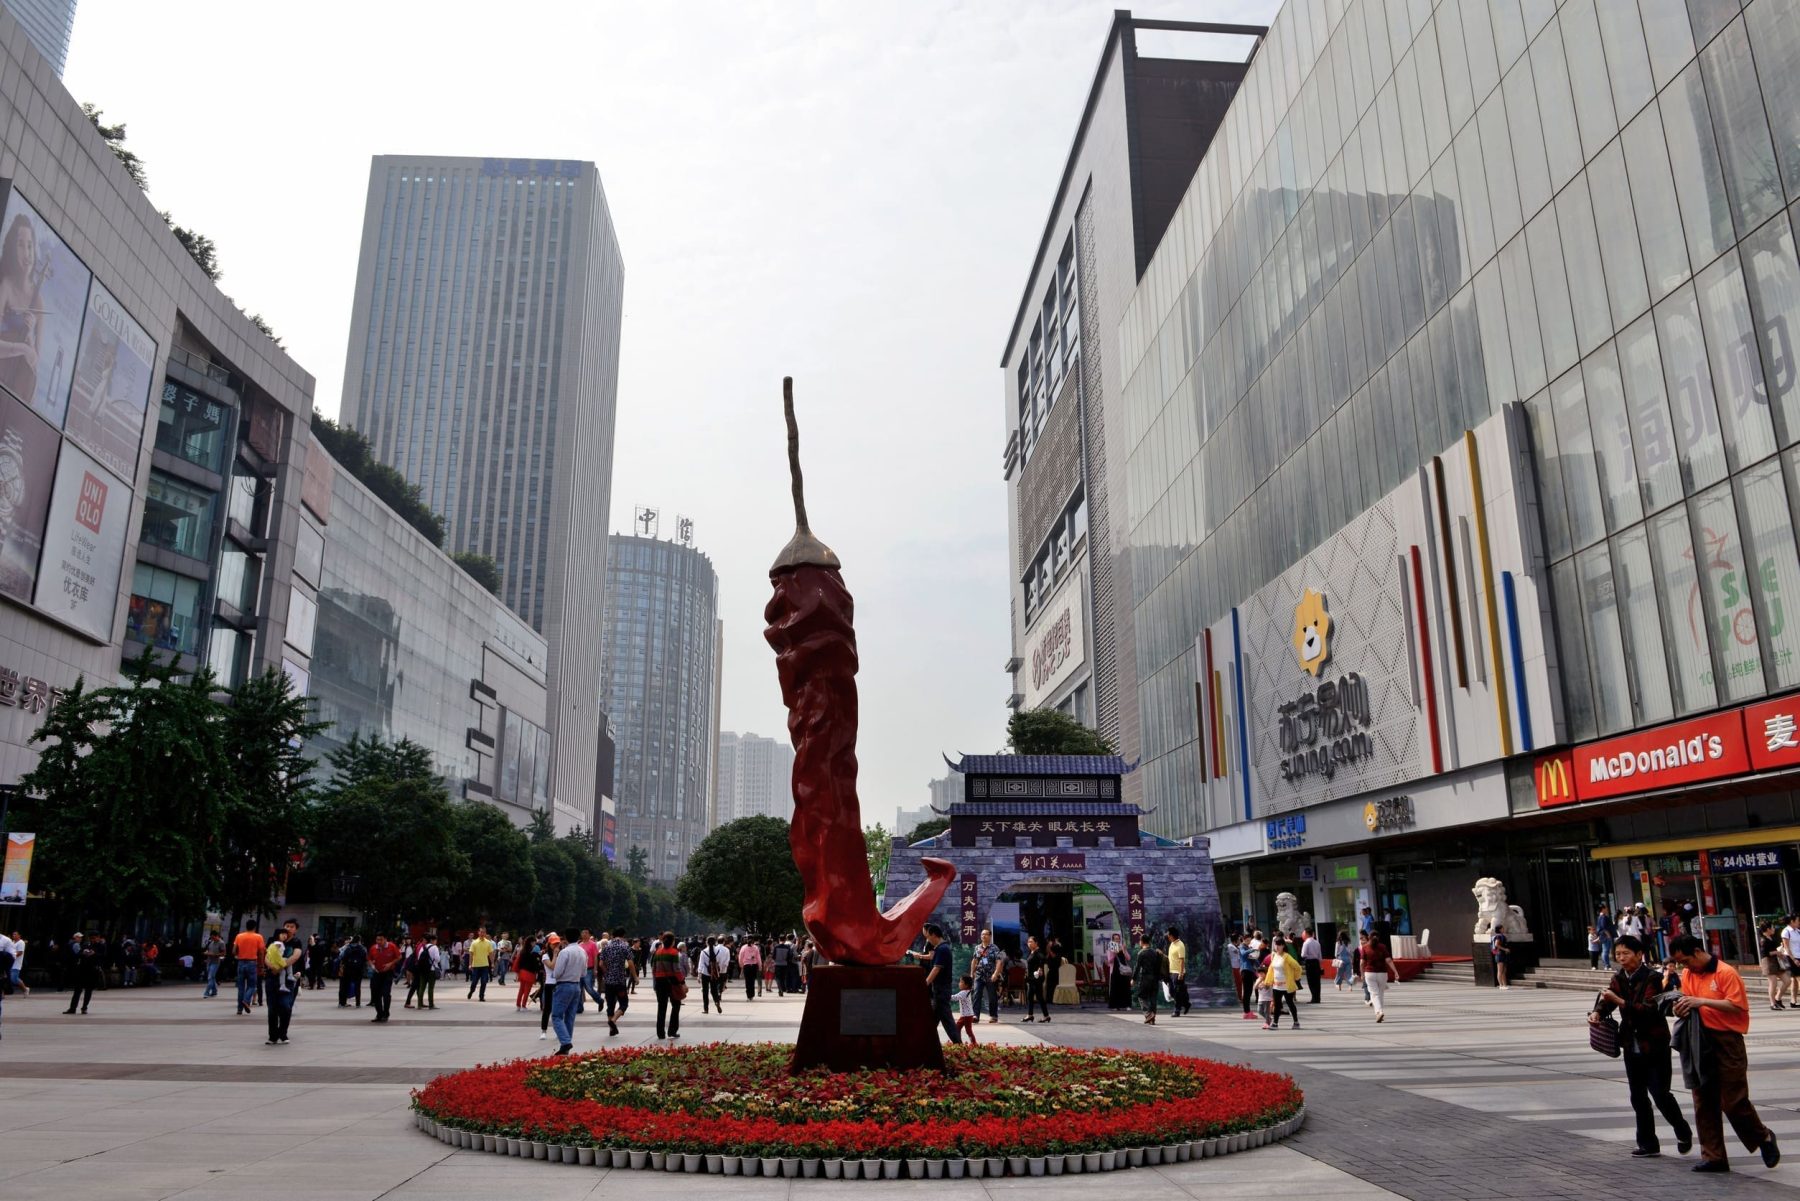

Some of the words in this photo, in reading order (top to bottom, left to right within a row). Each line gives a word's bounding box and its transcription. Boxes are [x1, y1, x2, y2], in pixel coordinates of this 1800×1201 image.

[94, 294, 130, 345] GOELIA
[79, 502, 100, 526] QLO
[84, 479, 103, 506] UNI
[63, 574, 90, 603] 优衣库
[1277, 671, 1371, 754] 苏宁易购
[1764, 713, 1799, 752] 麦
[1280, 732, 1373, 780] suning.com
[1590, 733, 1723, 783] McDonald's
[980, 821, 1043, 833] 天下雄关
[1048, 821, 1111, 833] 眼底长安
[1723, 851, 1779, 868] 24小时营业
[962, 881, 977, 937] 万夫莫开
[1129, 880, 1144, 937] 一夫当关
